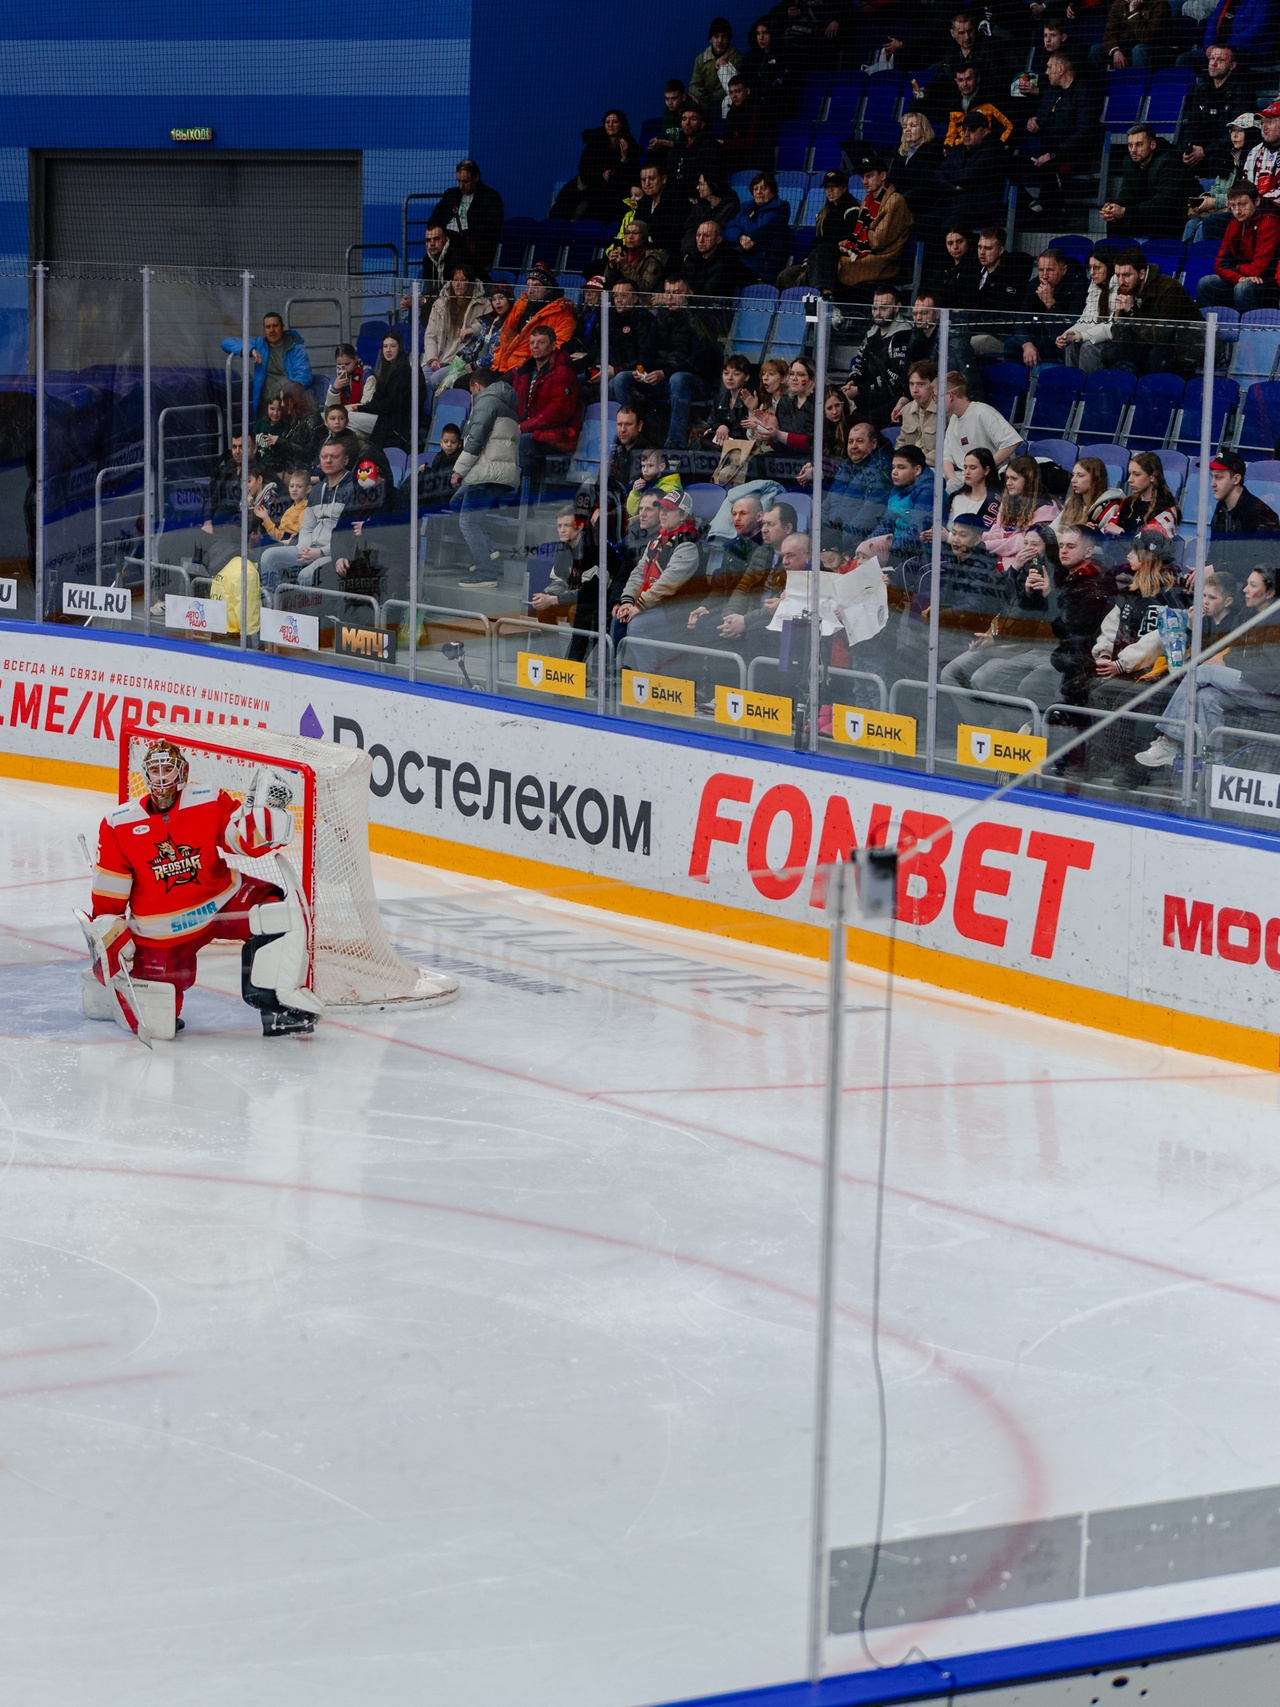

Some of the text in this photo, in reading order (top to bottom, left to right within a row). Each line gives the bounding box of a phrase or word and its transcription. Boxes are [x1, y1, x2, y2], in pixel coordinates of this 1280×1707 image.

[175, 128, 207, 140] ВЫХОД
[67, 588, 127, 613] KHL.RU
[4, 659, 45, 675] ВСЕГДА
[51, 665, 64, 676] НА
[70, 667, 105, 683] СВЯЗИ
[109, 673, 198, 698] #REDSTARHOCKEY
[201, 688, 270, 712] #UNITEDWEWIN
[545, 669, 575, 685] БАНК
[651, 686, 682, 703] БАНК
[746, 704, 779, 721] БАНК
[867, 723, 902, 741] БАНК
[994, 744, 1032, 762] БАНК
[152, 855, 203, 882] REDSTAR
[688, 772, 1095, 959] FONBET
[170, 901, 218, 933] SIBUR
